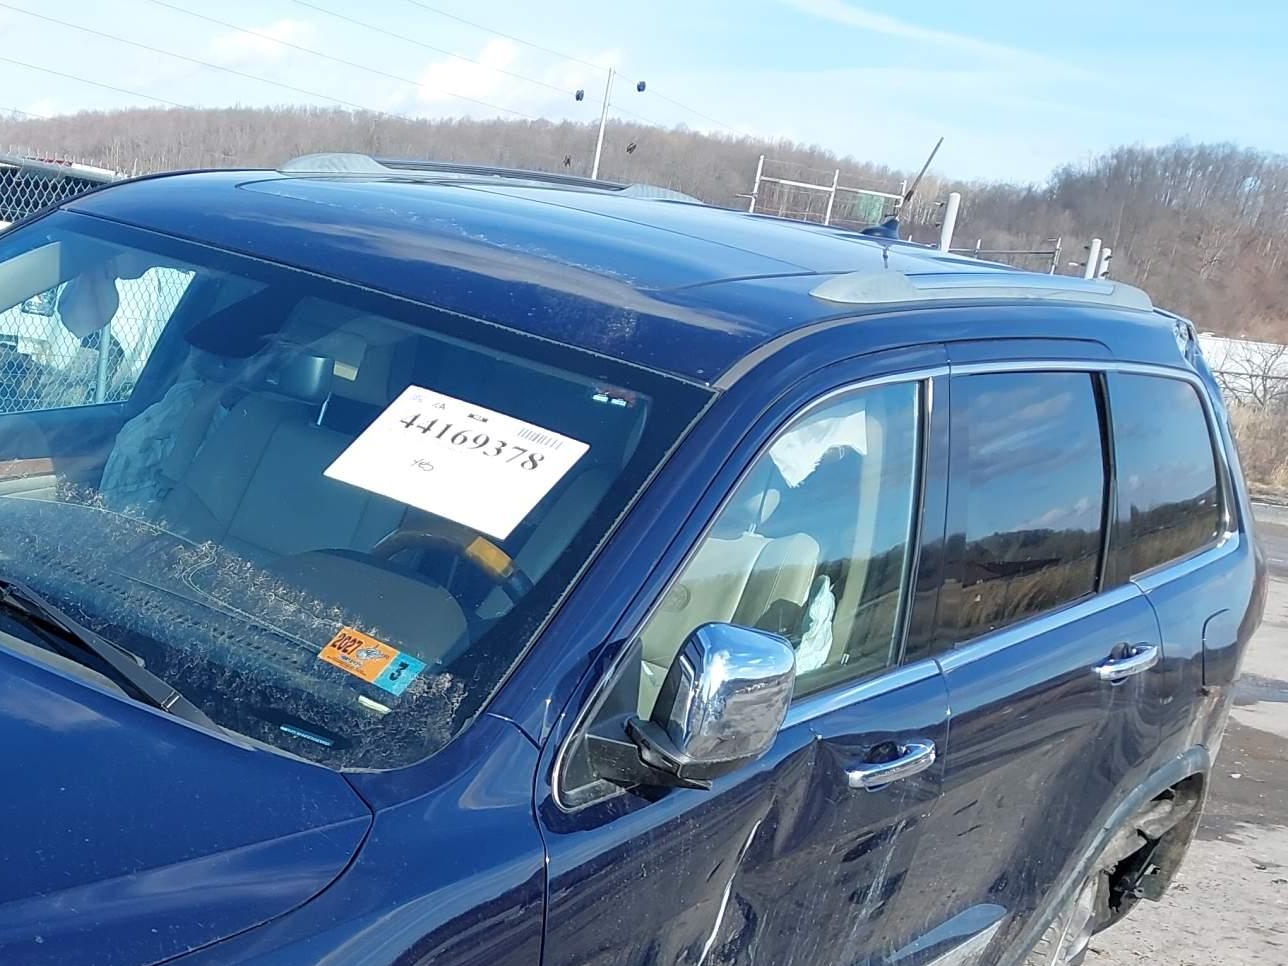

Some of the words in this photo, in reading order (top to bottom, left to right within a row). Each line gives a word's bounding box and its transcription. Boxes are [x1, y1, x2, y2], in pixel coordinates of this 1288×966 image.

[400, 413, 545, 470] 44169378
[330, 633, 365, 655] 2027
[389, 661, 410, 681] 3
